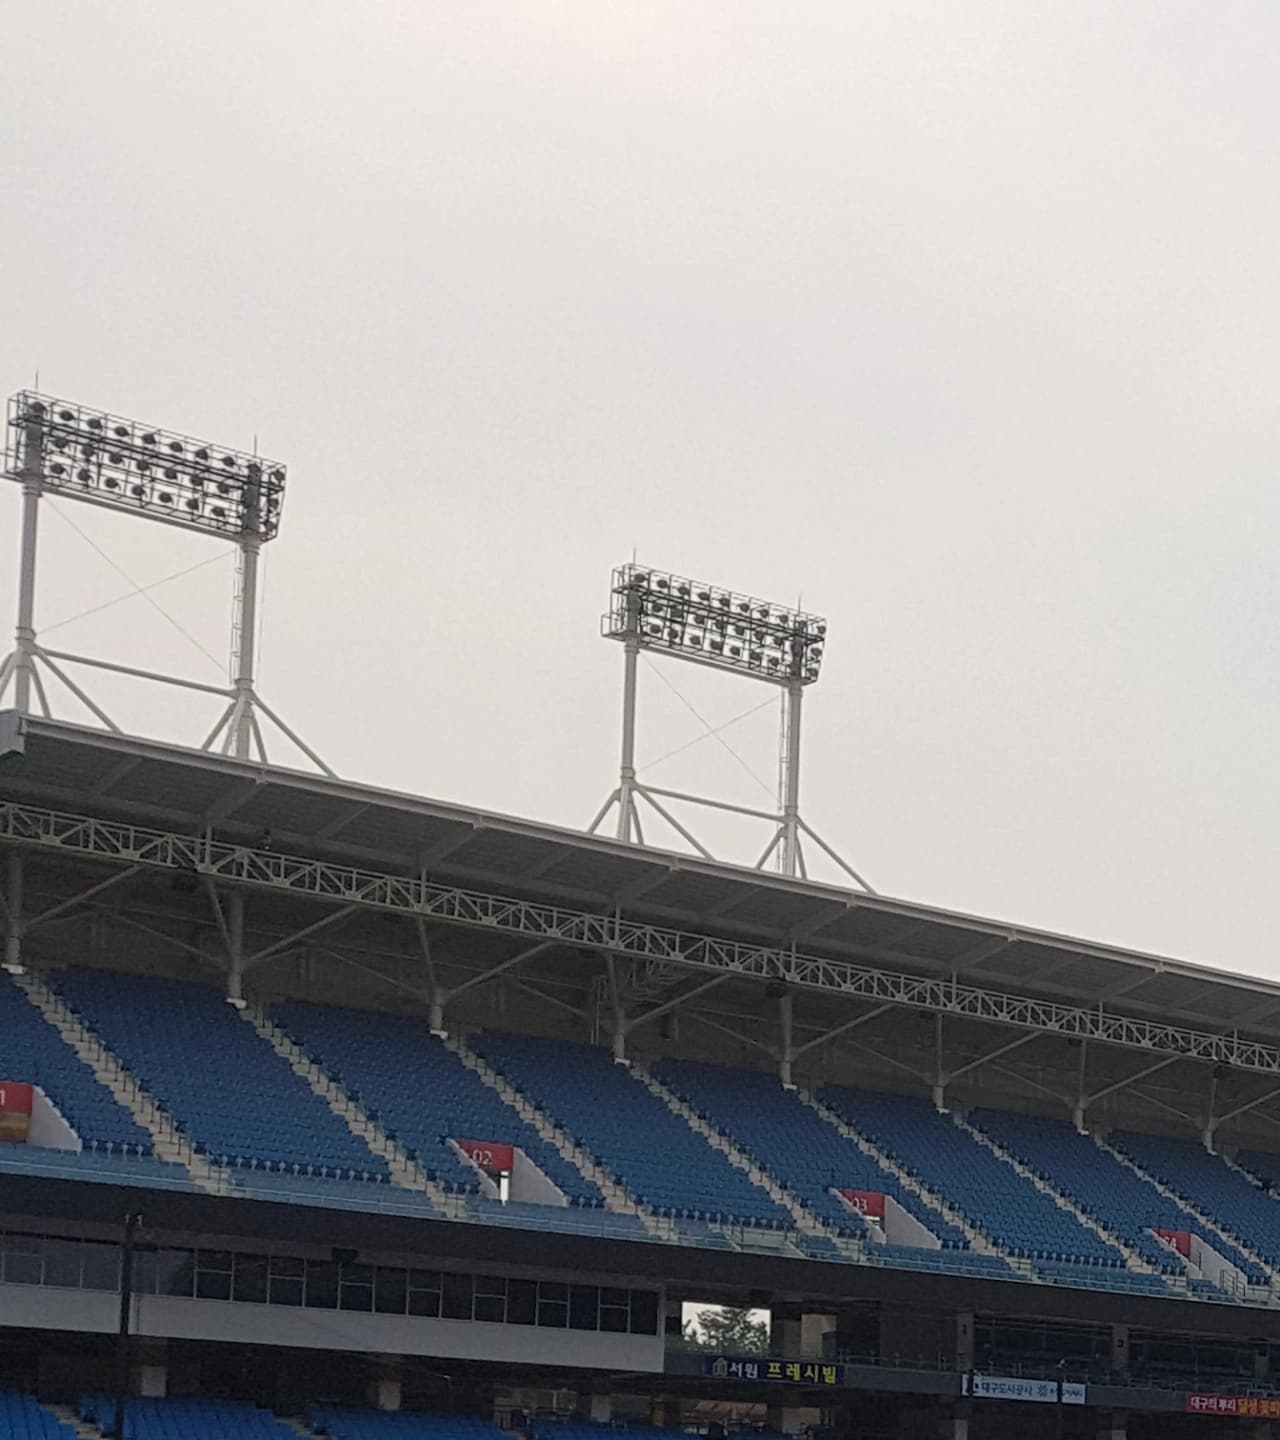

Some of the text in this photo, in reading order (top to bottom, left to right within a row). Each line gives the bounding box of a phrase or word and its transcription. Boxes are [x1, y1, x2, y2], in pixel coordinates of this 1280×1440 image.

[473, 1149, 493, 1165] 02
[728, 1361, 837, 1385] 서원 프레시빌
[1190, 1396, 1217, 1411] 대구의
